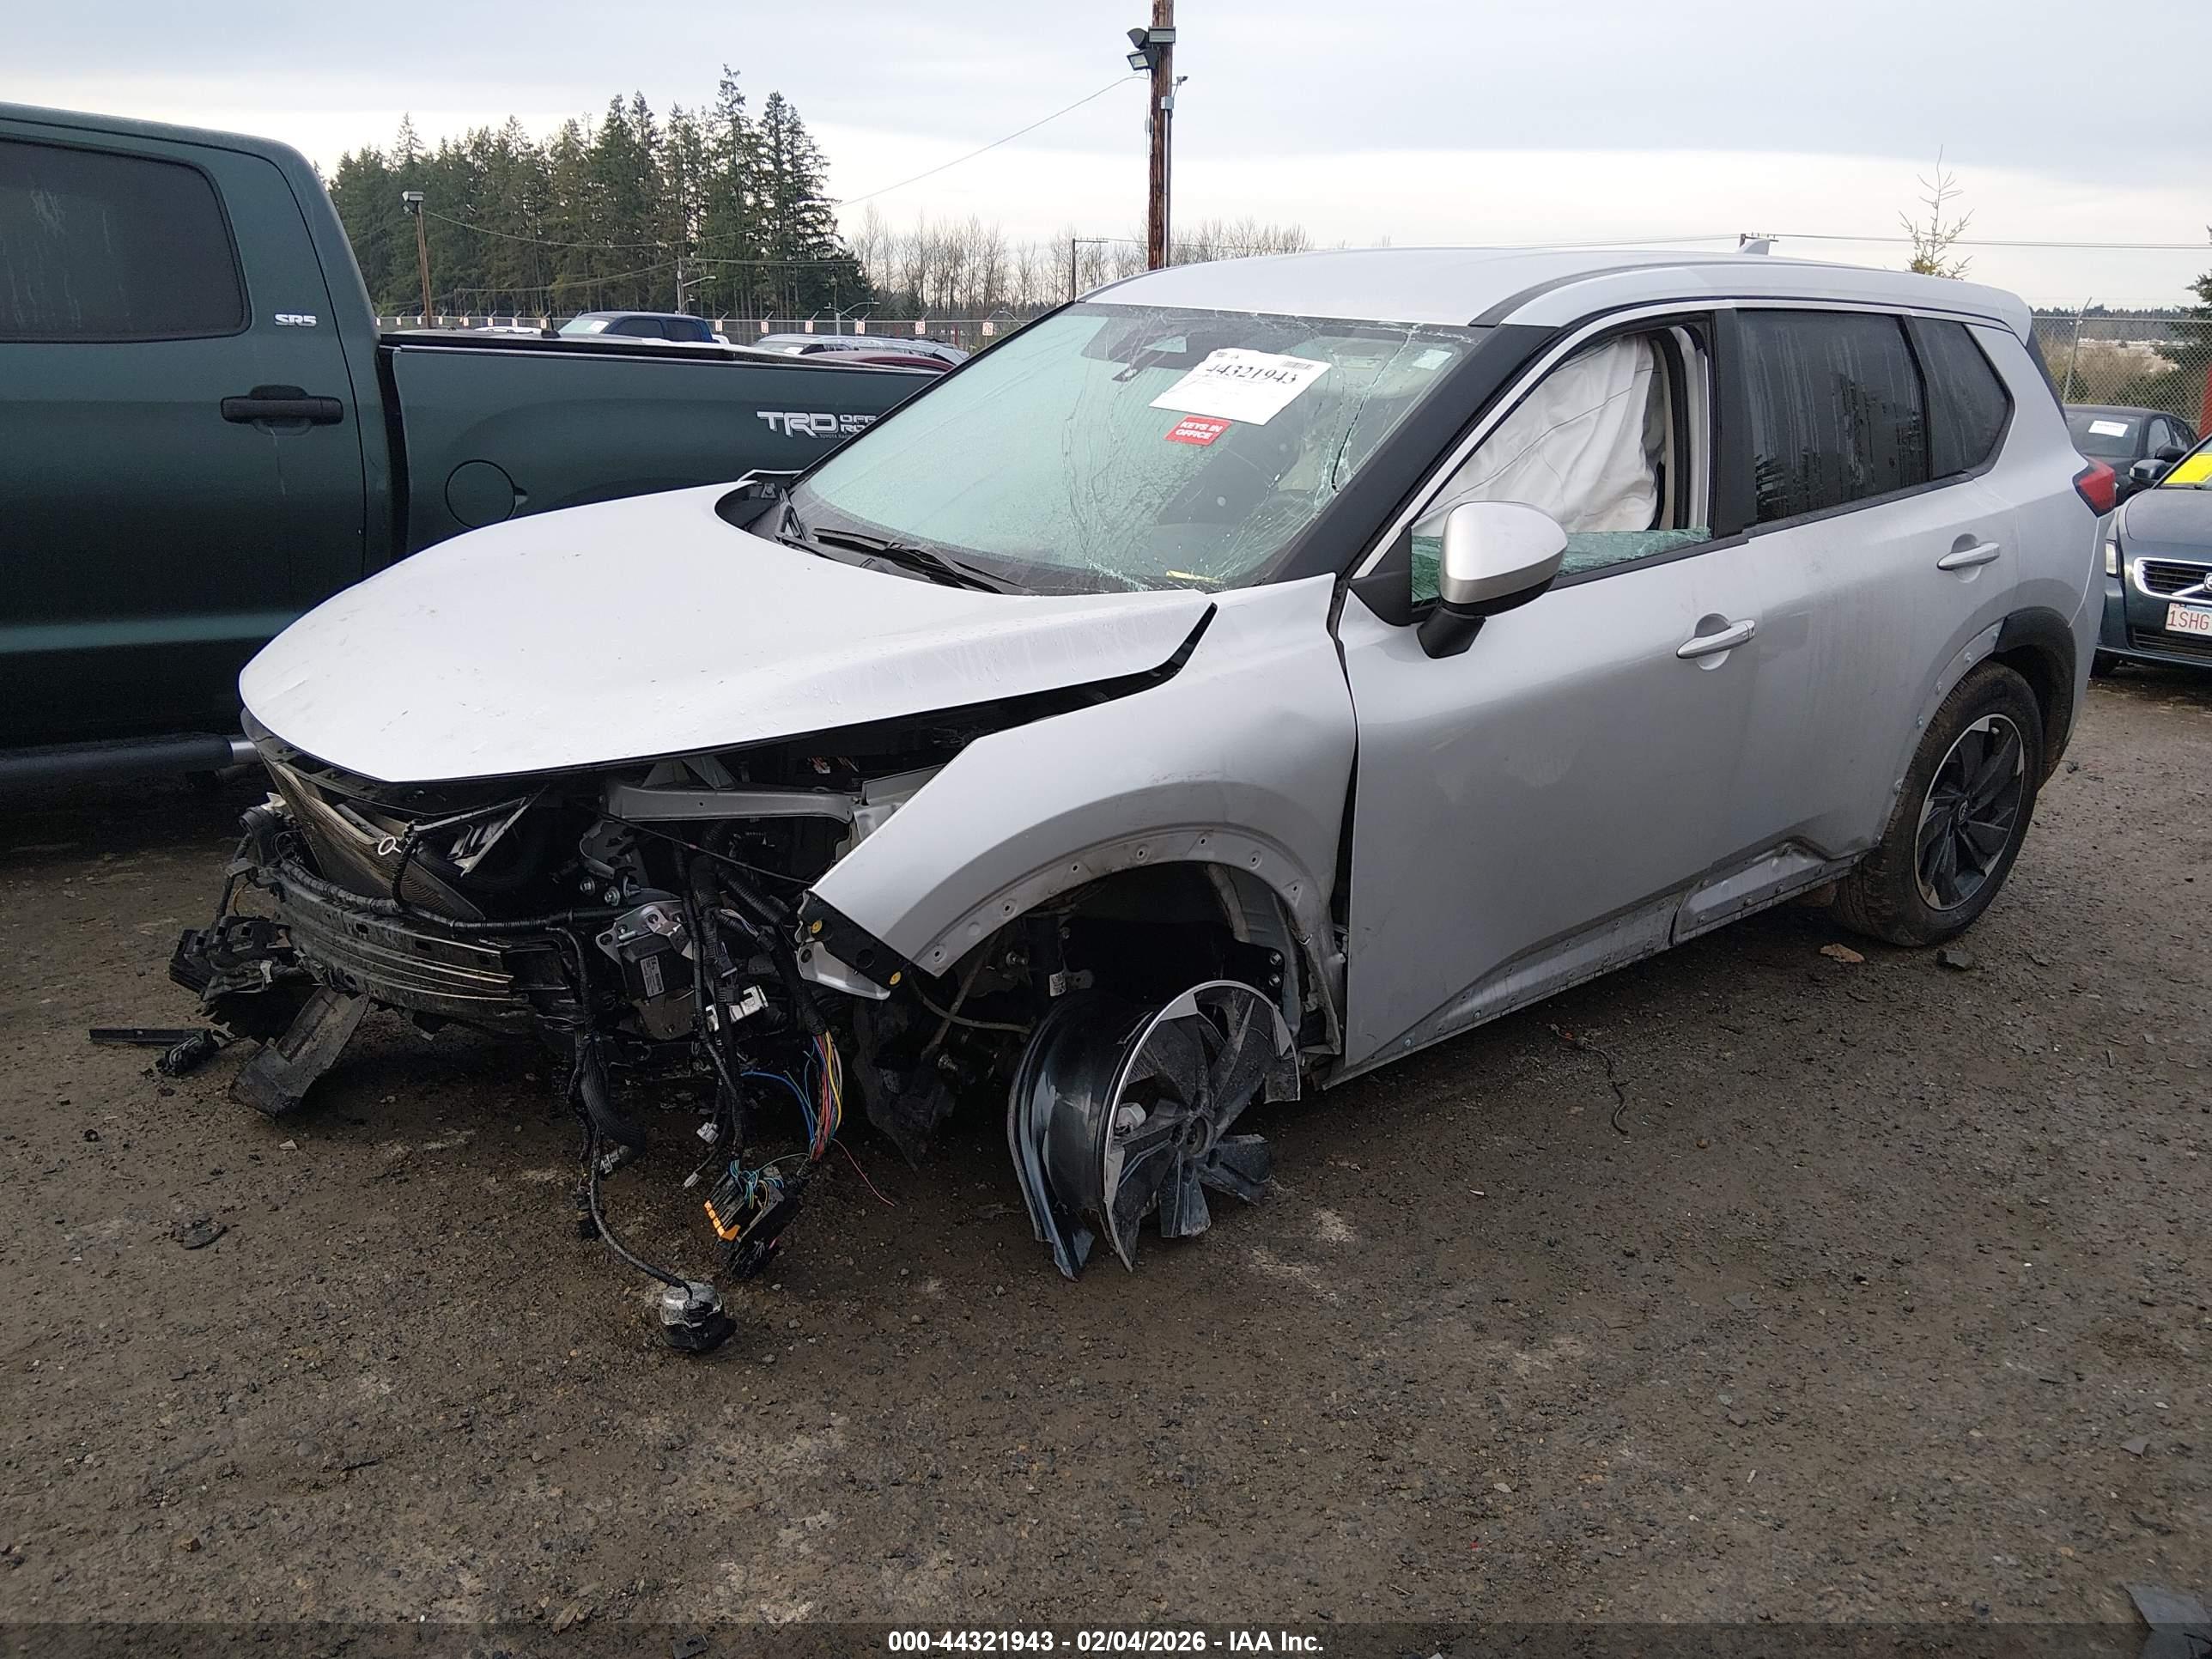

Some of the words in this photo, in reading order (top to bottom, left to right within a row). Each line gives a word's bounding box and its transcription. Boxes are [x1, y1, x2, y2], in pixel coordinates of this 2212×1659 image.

[274, 313, 318, 327] SR5
[1206, 363, 1298, 385] 44321943
[757, 410, 838, 439] TRD
[839, 414, 878, 423] OFF
[840, 423, 866, 434] RO
[1180, 421, 1209, 431] KEYS
[1209, 424, 1224, 433] IN
[1175, 429, 1214, 440] OFFICE
[2167, 610, 2211, 630] 1SHG
